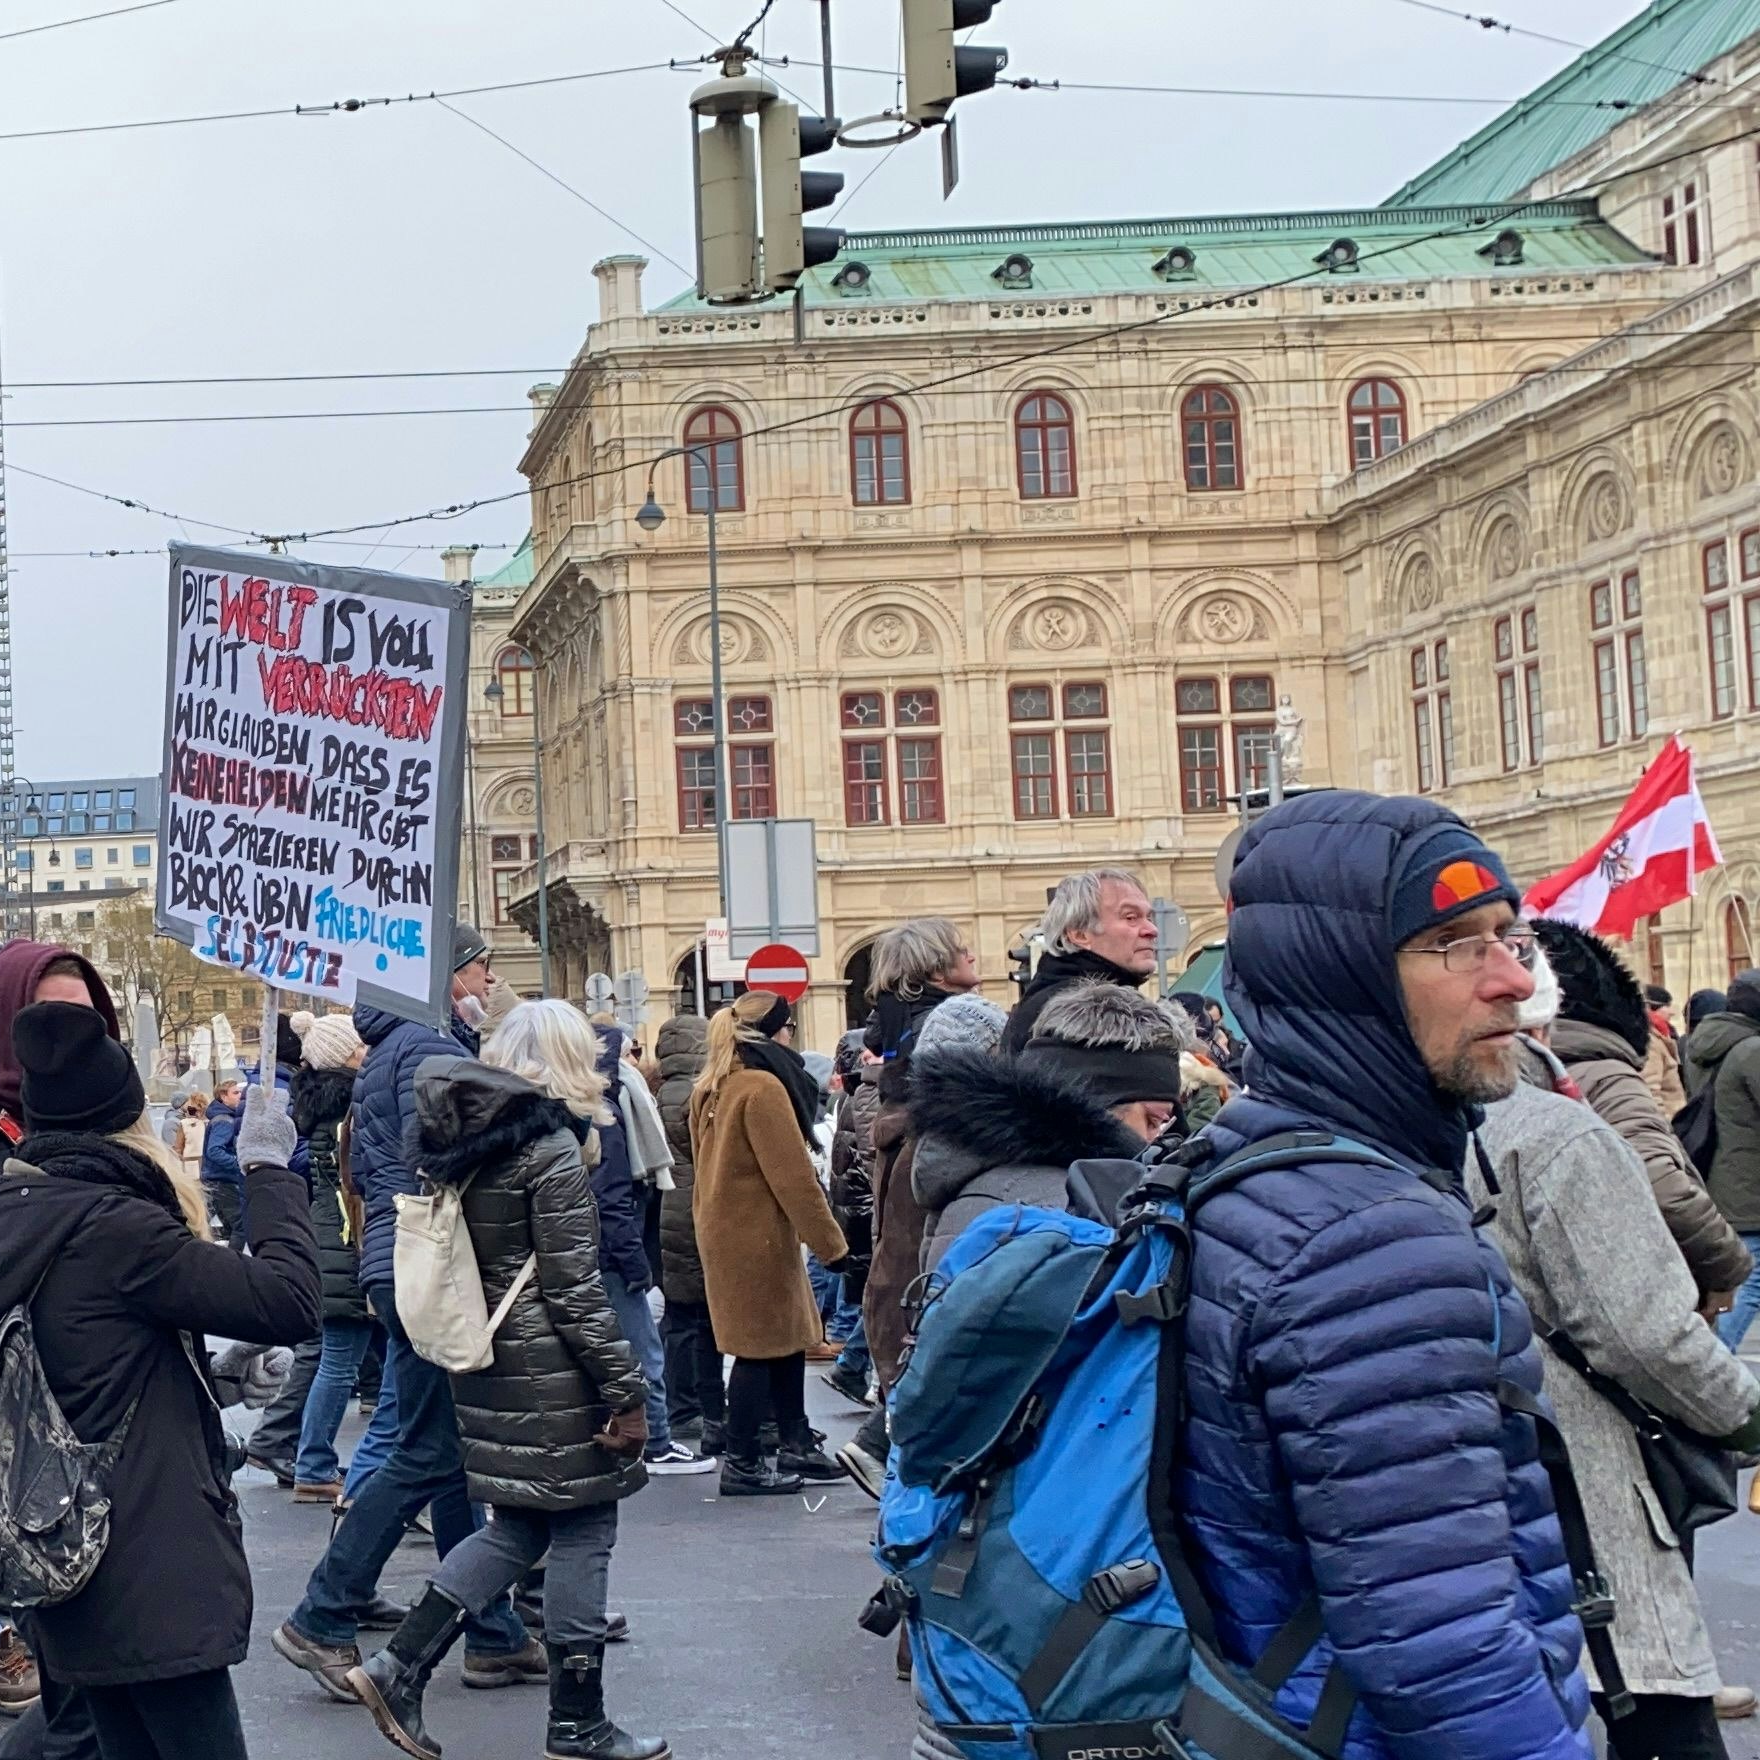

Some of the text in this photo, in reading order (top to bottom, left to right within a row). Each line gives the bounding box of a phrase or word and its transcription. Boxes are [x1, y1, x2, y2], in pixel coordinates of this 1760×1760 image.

[181, 570, 434, 673] DIE WELT IS VOLL
[184, 633, 443, 744] MIT VERRÜCKTEN
[174, 692, 217, 741] WIR
[313, 734, 390, 795] DASS
[394, 757, 432, 811] ES
[169, 802, 432, 908] WIR SPAZIEREN DURCHN
[310, 782, 380, 842] MEHR
